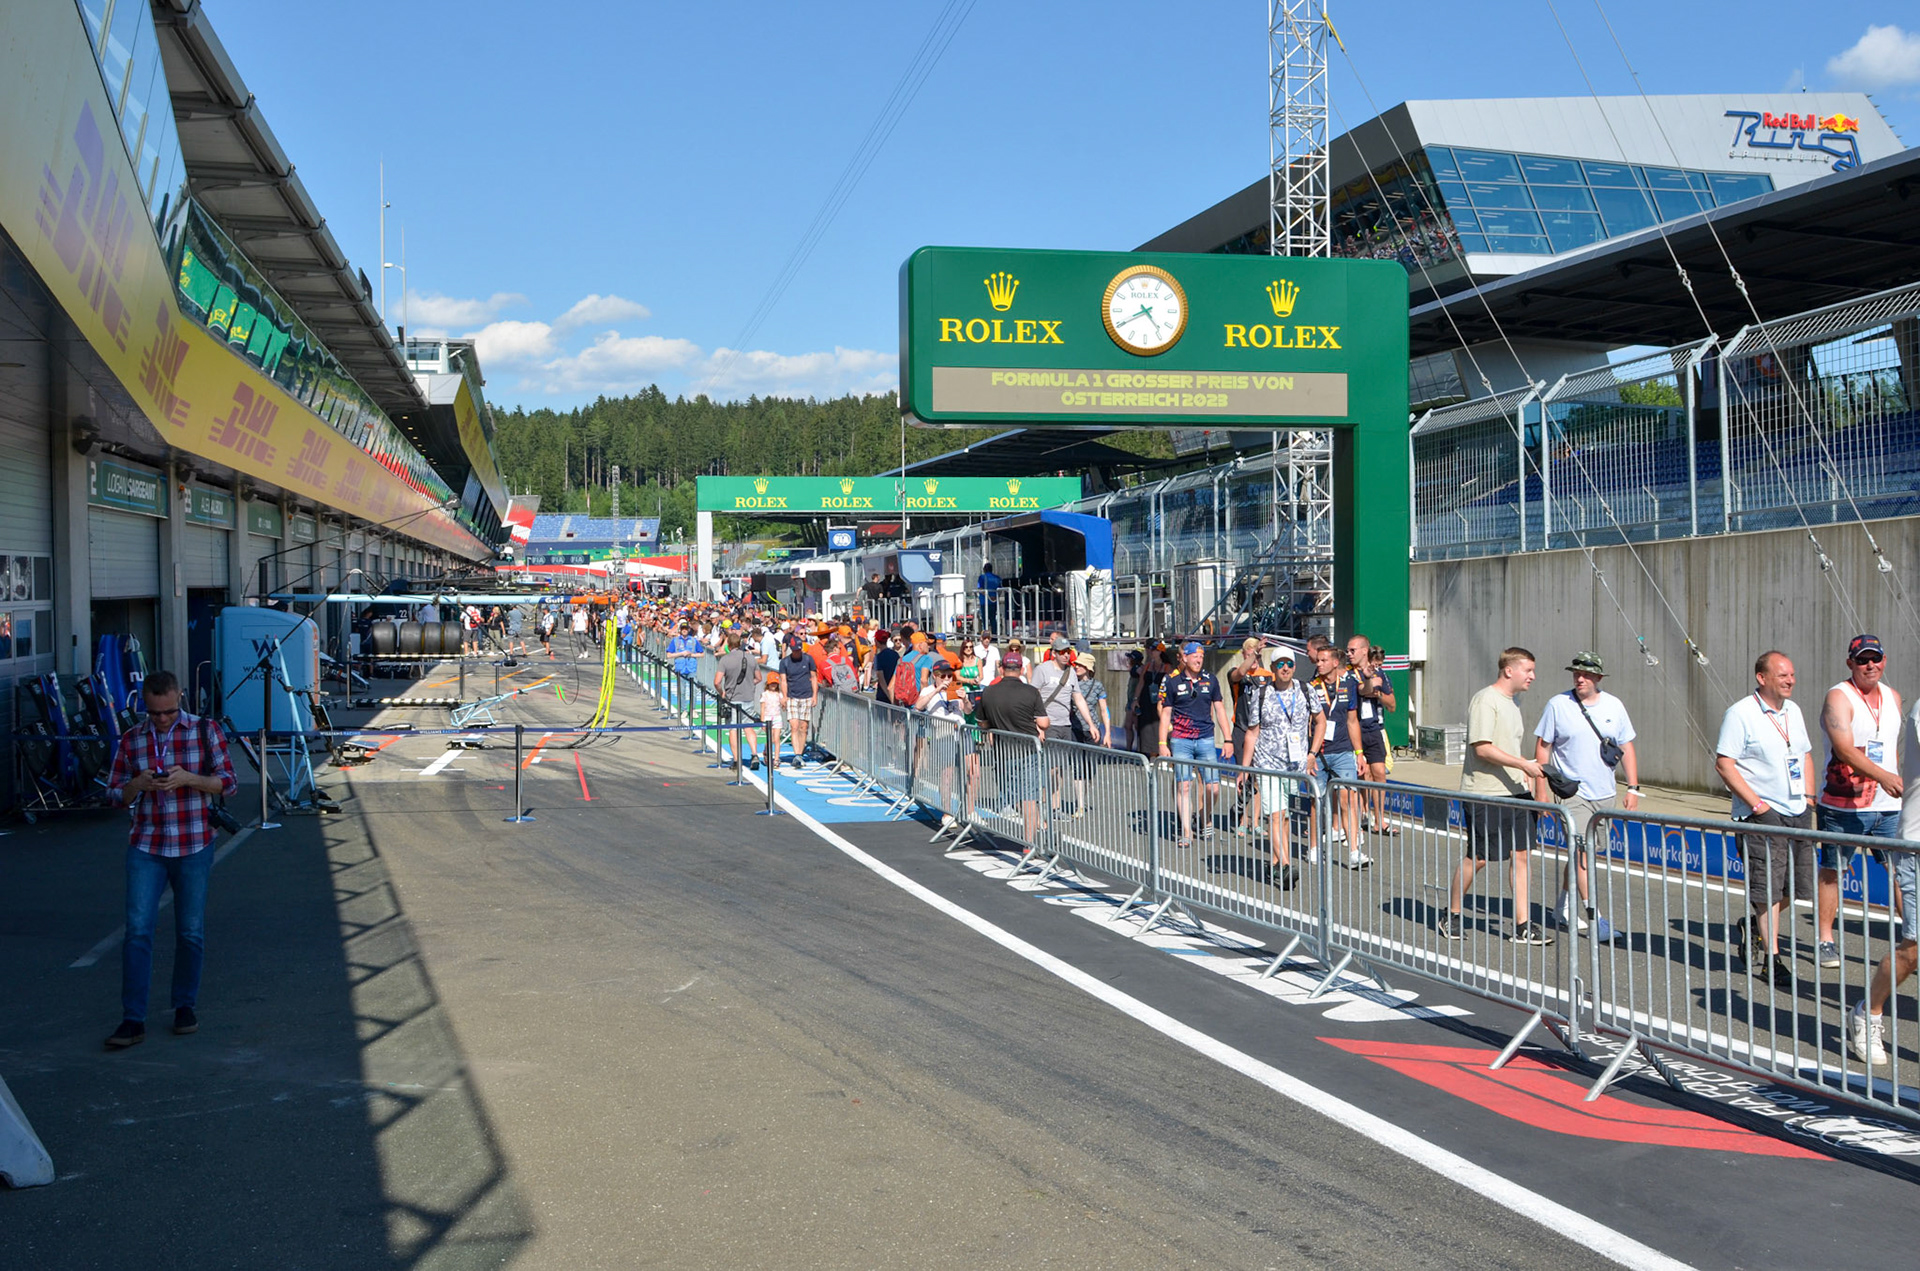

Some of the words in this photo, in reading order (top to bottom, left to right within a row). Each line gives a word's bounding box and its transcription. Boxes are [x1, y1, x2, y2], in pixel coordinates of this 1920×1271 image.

[1763, 112, 1789, 129] Red
[1790, 113, 1816, 130] Bull
[1729, 151, 1830, 163] SPIELBERG
[939, 317, 1065, 345] ROLEX
[1223, 323, 1342, 350] ROLEX
[991, 371, 1089, 387] FORMULA
[1092, 373, 1103, 387] 1
[1106, 373, 1193, 389] GROSSER
[1196, 375, 1249, 389] PREIS
[1252, 376, 1294, 391] VON
[1182, 393, 1229, 407] 2023
[90, 461, 97, 496] 2
[107, 472, 128, 494] LOGAN
[128, 478, 156, 501] SARGEANT
[735, 497, 788, 508] ROLEX
[822, 497, 873, 508] ROLEX
[907, 497, 957, 508] ROLEX
[989, 497, 1040, 508] ROLEX
[545, 596, 565, 604] Gulf
[399, 610, 407, 618] 22
[1718, 1080, 1830, 1113] World
[1728, 1096, 1797, 1118] FIA
